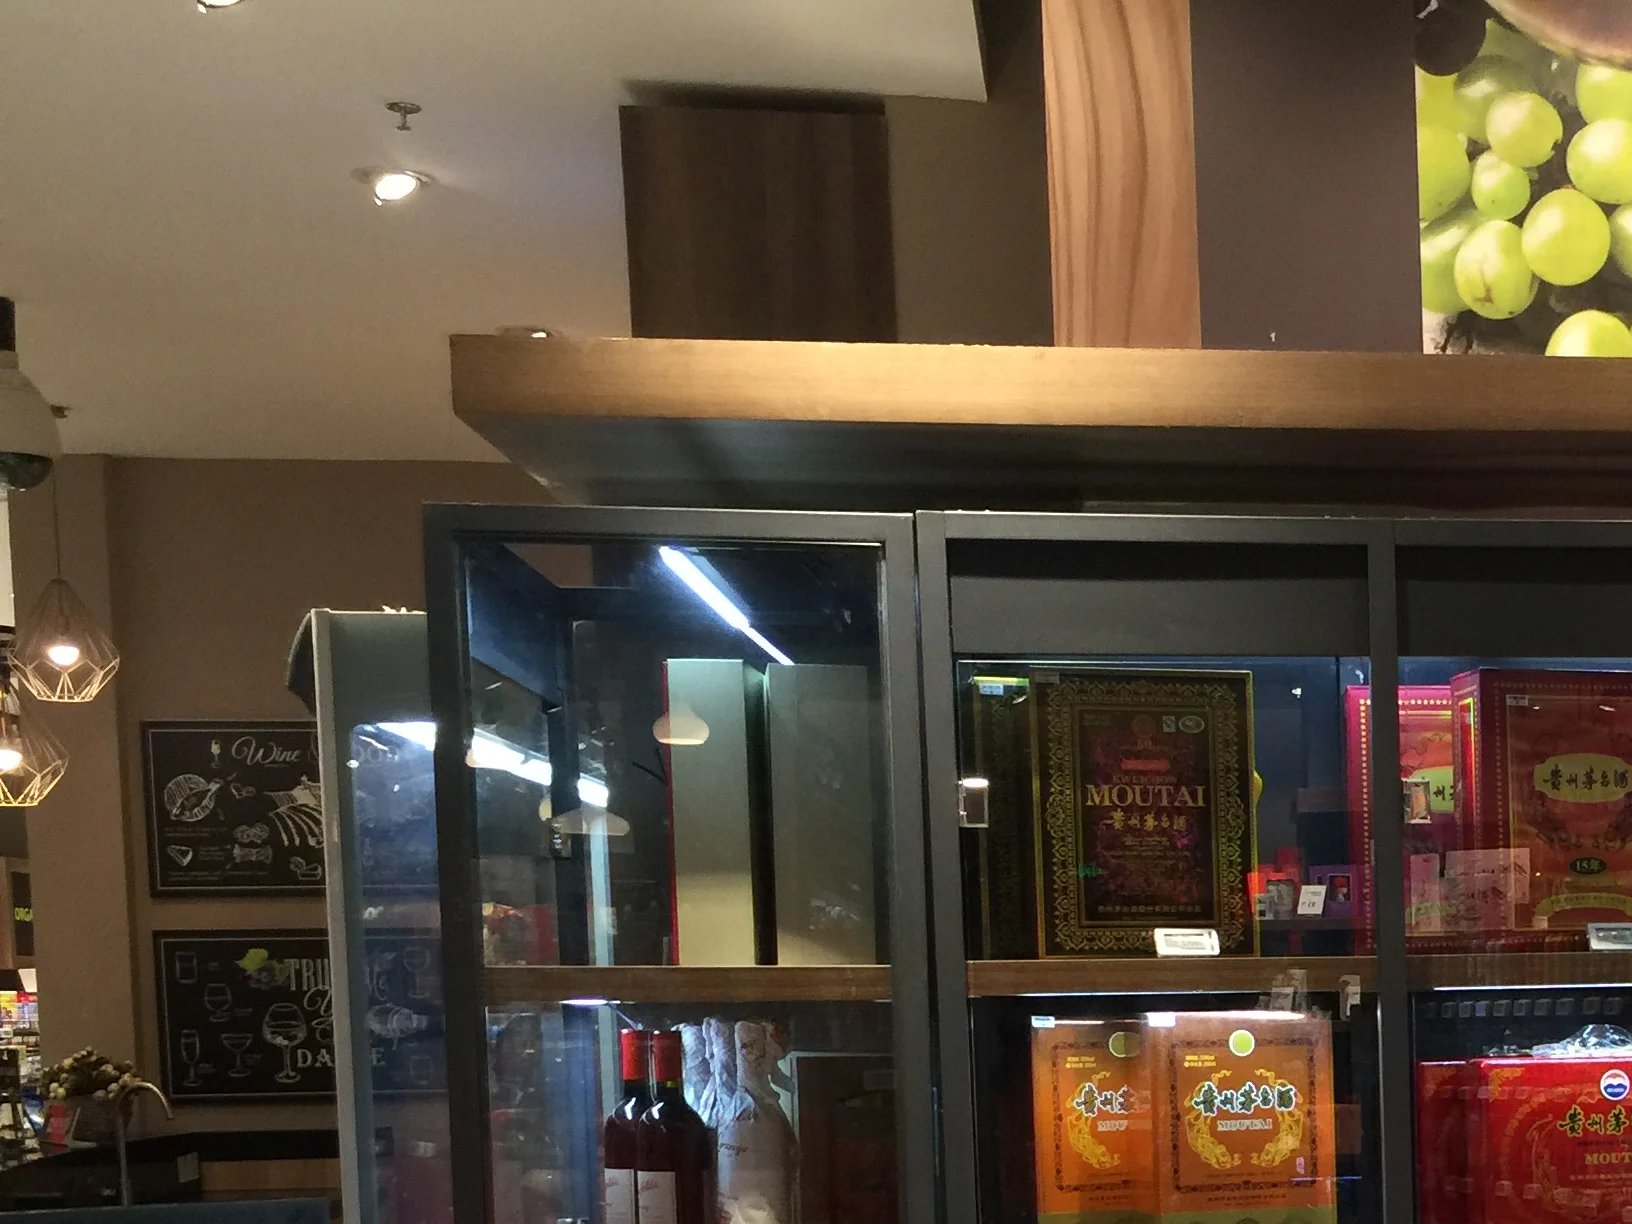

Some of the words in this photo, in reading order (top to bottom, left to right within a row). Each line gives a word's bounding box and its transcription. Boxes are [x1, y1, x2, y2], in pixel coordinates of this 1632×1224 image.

[231, 735, 300, 765] Wine
[1543, 763, 1629, 791] 贵州茅台酒
[1085, 784, 1207, 807] MOUTAI
[1192, 1082, 1296, 1117] 贵州茅台酒
